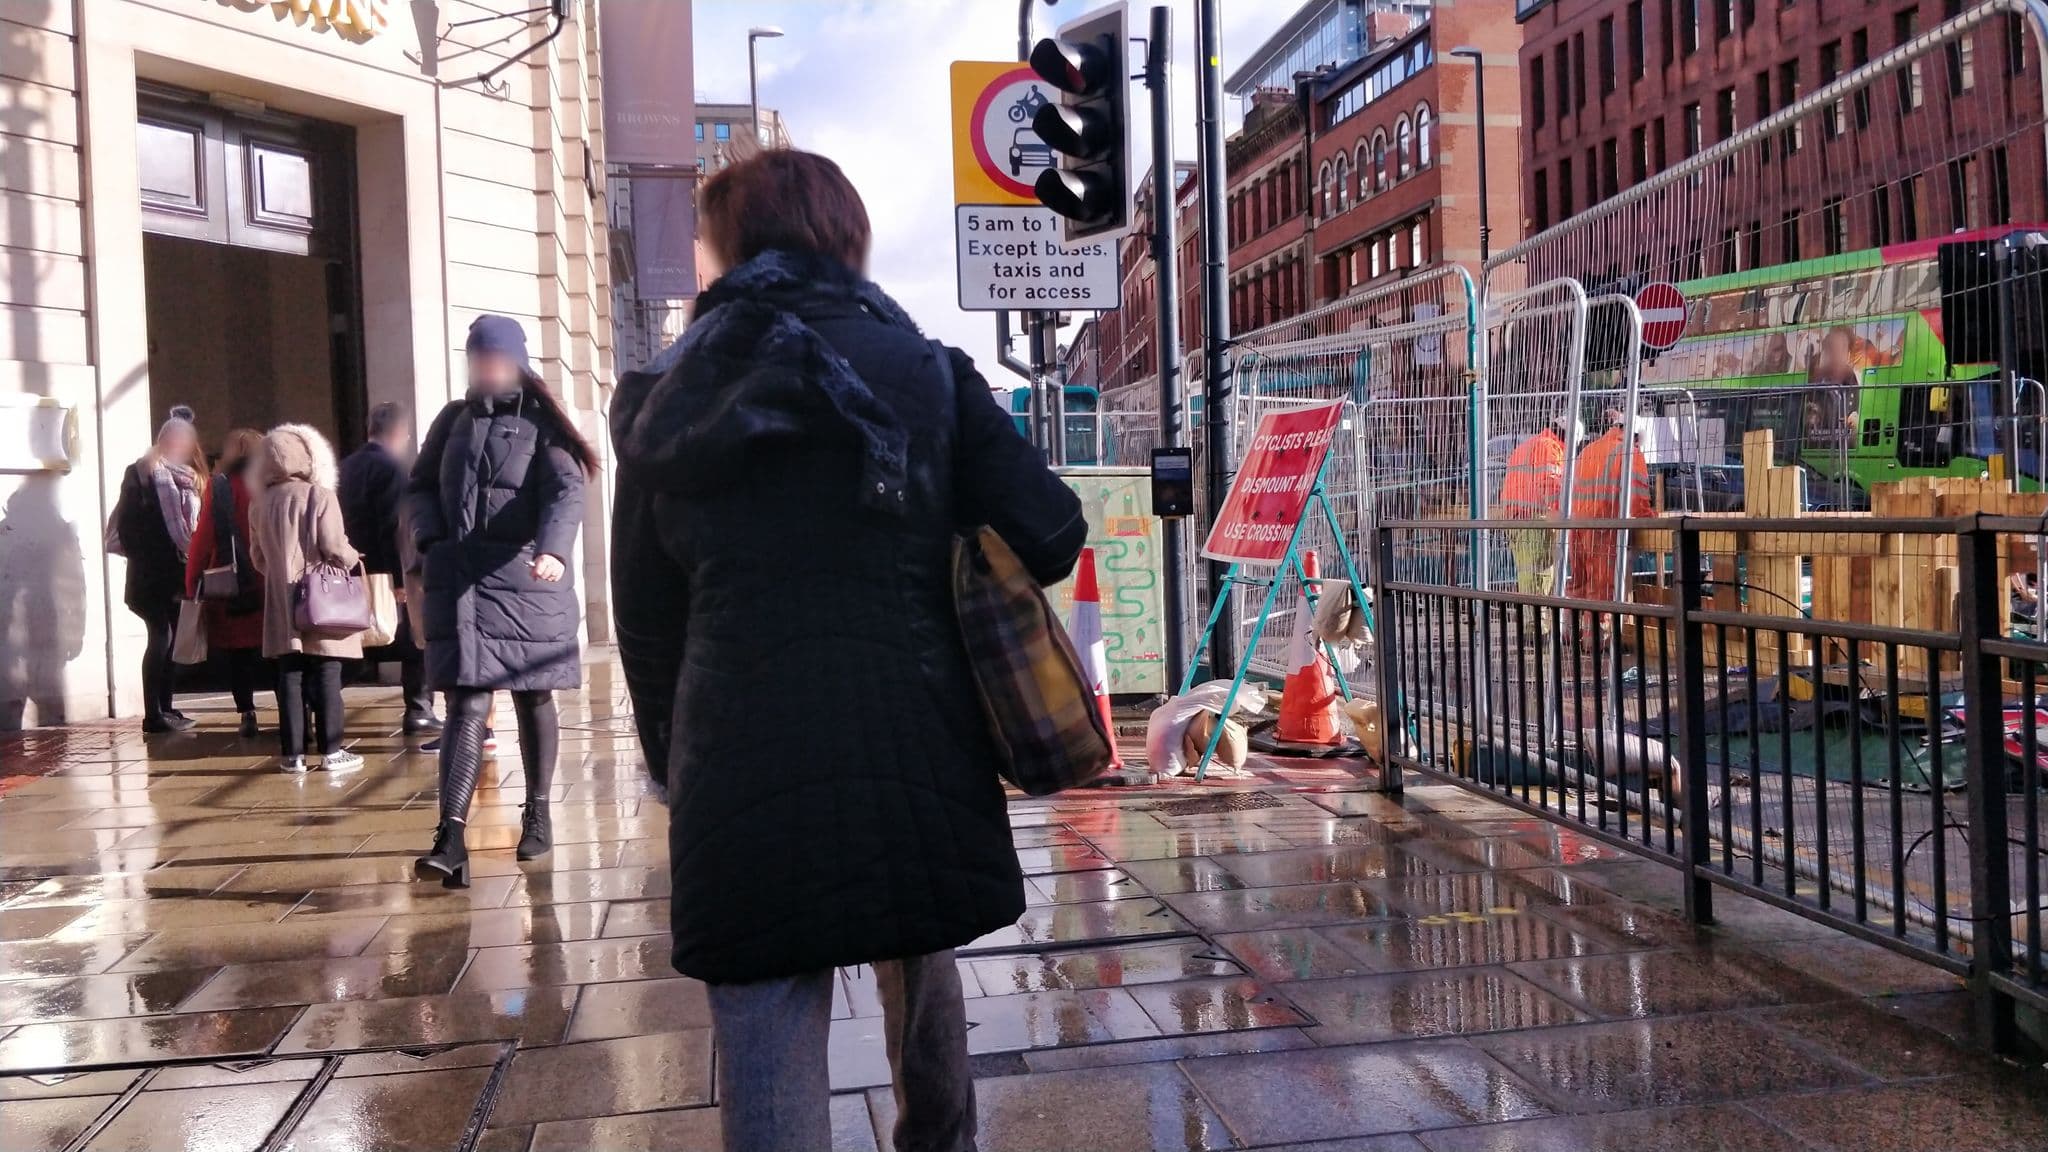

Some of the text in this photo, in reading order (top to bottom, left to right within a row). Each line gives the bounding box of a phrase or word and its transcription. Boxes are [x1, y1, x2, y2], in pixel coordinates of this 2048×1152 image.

[968, 215, 980, 232] 5
[985, 217, 1014, 232] am
[1022, 216, 1042, 232] to
[968, 240, 1038, 259] Except
[993, 261, 1084, 278] taxis and
[988, 283, 1091, 299] for access
[1254, 432, 1305, 451] CYCLISTS
[1241, 476, 1298, 494] DISMOUNT
[1224, 522, 1248, 540] USE
